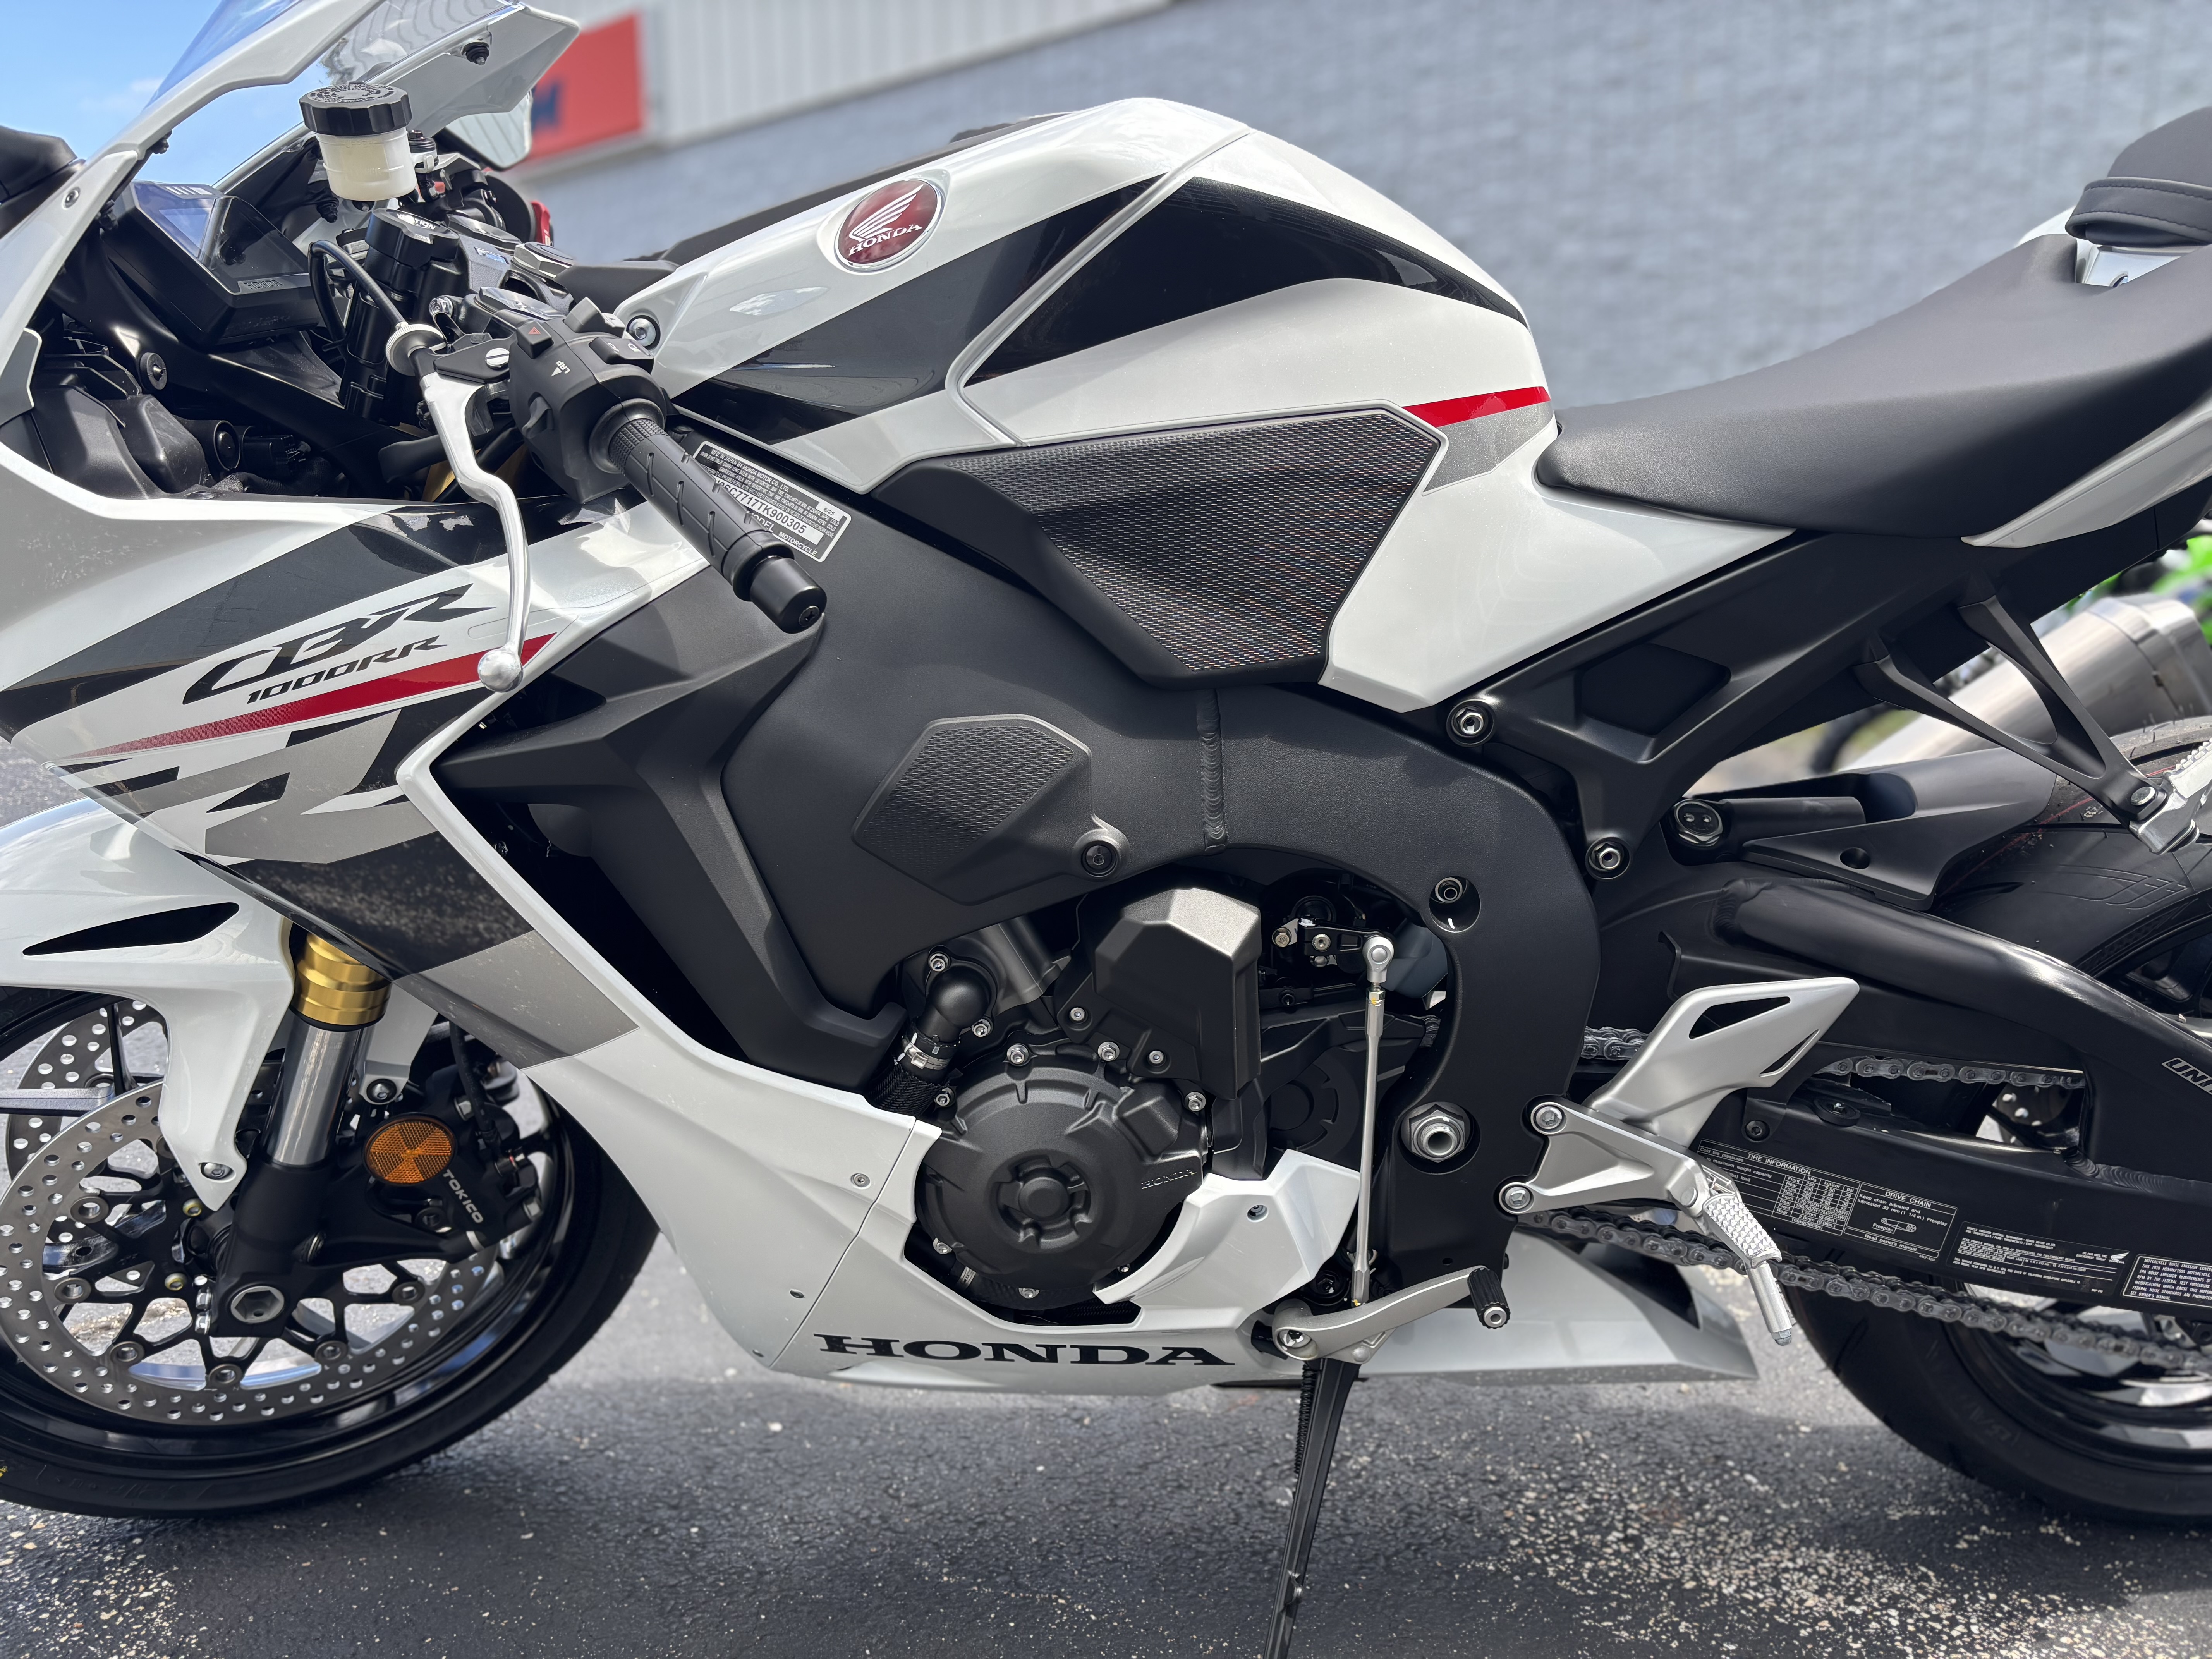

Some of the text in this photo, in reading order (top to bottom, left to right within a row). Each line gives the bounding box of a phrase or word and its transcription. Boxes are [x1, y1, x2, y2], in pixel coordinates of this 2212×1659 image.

[848, 223, 923, 256] HONDA
[244, 279, 284, 290] HONDA
[556, 360, 571, 374] LAP
[710, 448, 721, 457] MFD.
[724, 455, 738, 465] JAPAN
[742, 465, 757, 475] HONDA
[756, 472, 772, 483] MOTOR
[780, 484, 790, 492] LTD.
[823, 507, 835, 516] 6/25
[778, 531, 817, 556] MOTORCYCLE
[183, 583, 495, 705] CBR
[247, 635, 448, 704] 1000RR
[2166, 1059, 2212, 1093] UNI
[1721, 1153, 1744, 1163] pressures
[1747, 1153, 1811, 1175] TIRE INFORMATION
[1141, 1169, 1197, 1189] HONDA
[1712, 1159, 1735, 1168] maximum
[1753, 1170, 1772, 1179] capacity
[444, 1169, 483, 1224] TOKICO
[1884, 1191, 1932, 1208] DRIVE CHAIN
[1888, 1202, 1909, 1211] adjusted
[1857, 1199, 1881, 1208] lubricated
[1926, 1217, 1948, 1227] Freeplay
[1872, 1223, 1894, 1232] Freeplay
[1879, 1238, 1898, 1246] owner's
[813, 1333, 1236, 1366] HONDA
